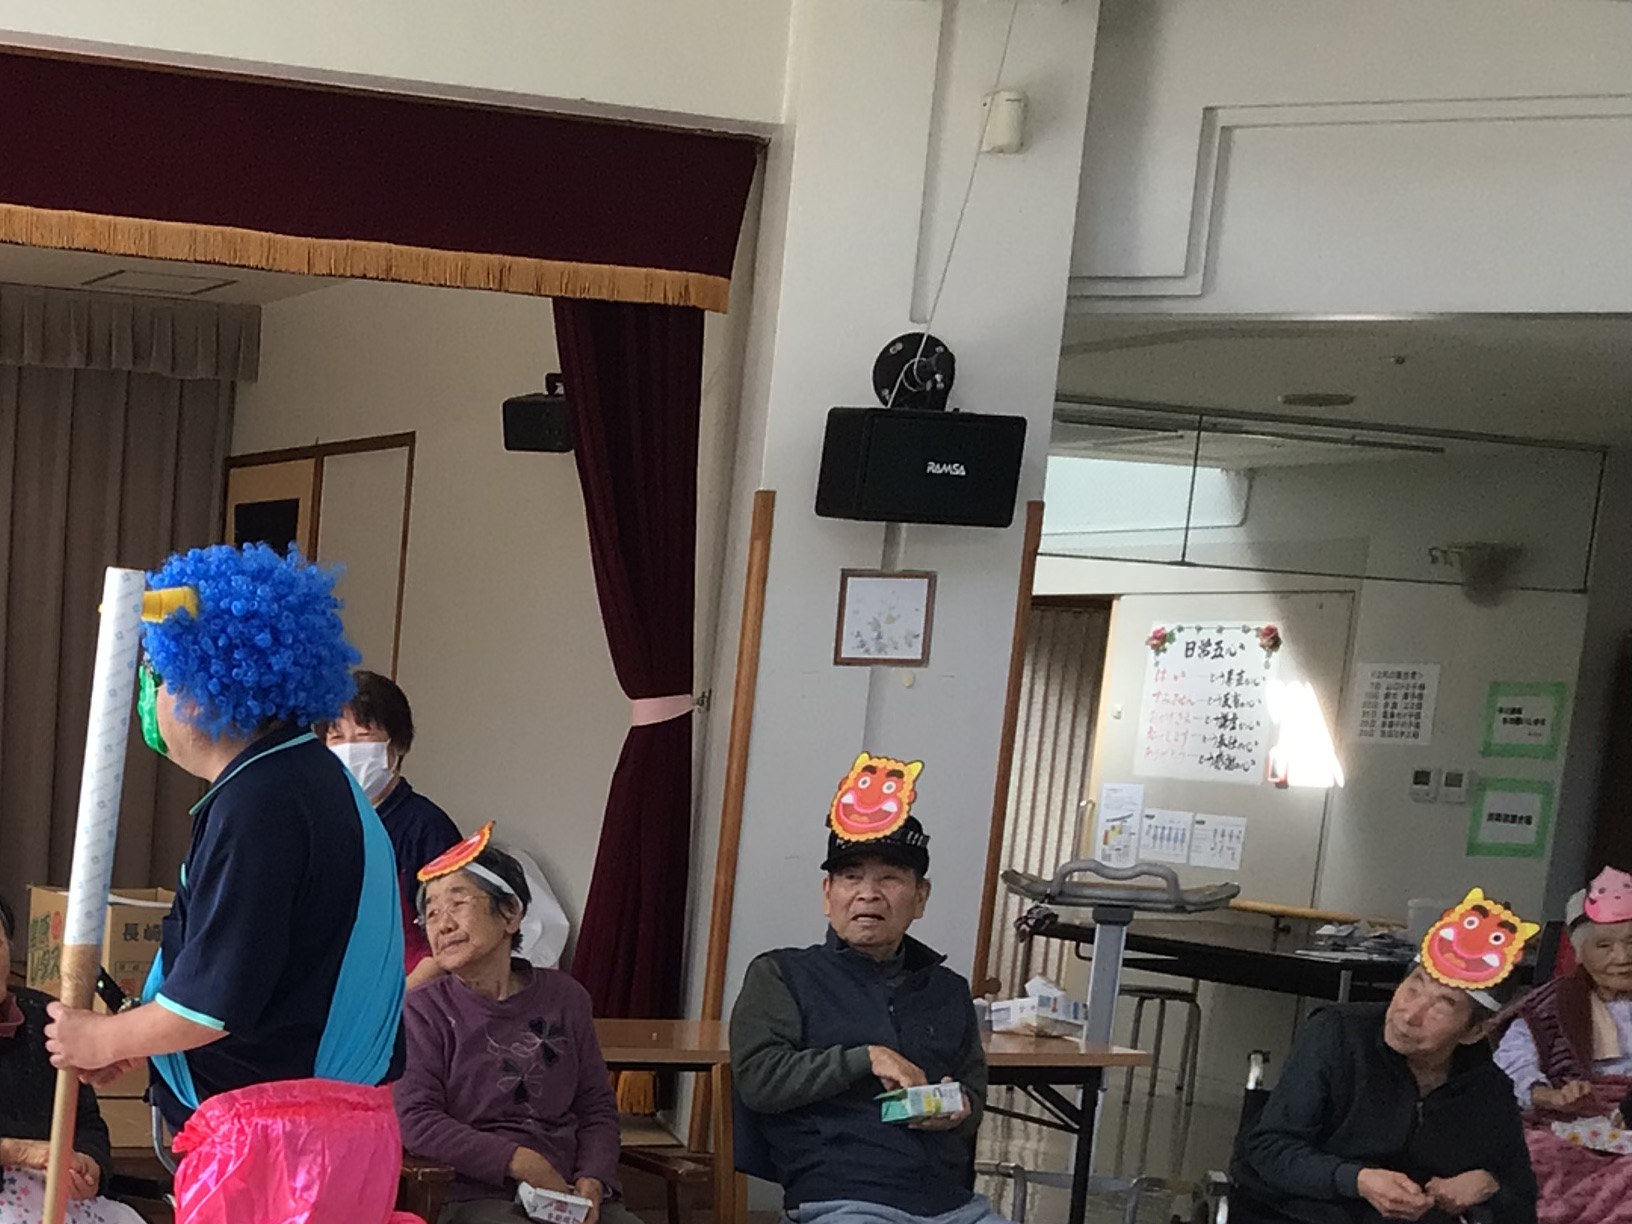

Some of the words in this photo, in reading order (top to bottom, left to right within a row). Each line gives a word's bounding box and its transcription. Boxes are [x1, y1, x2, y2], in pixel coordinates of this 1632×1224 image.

[926, 461, 966, 476] RAMSA
[1184, 638, 1246, 660] 日常五心
